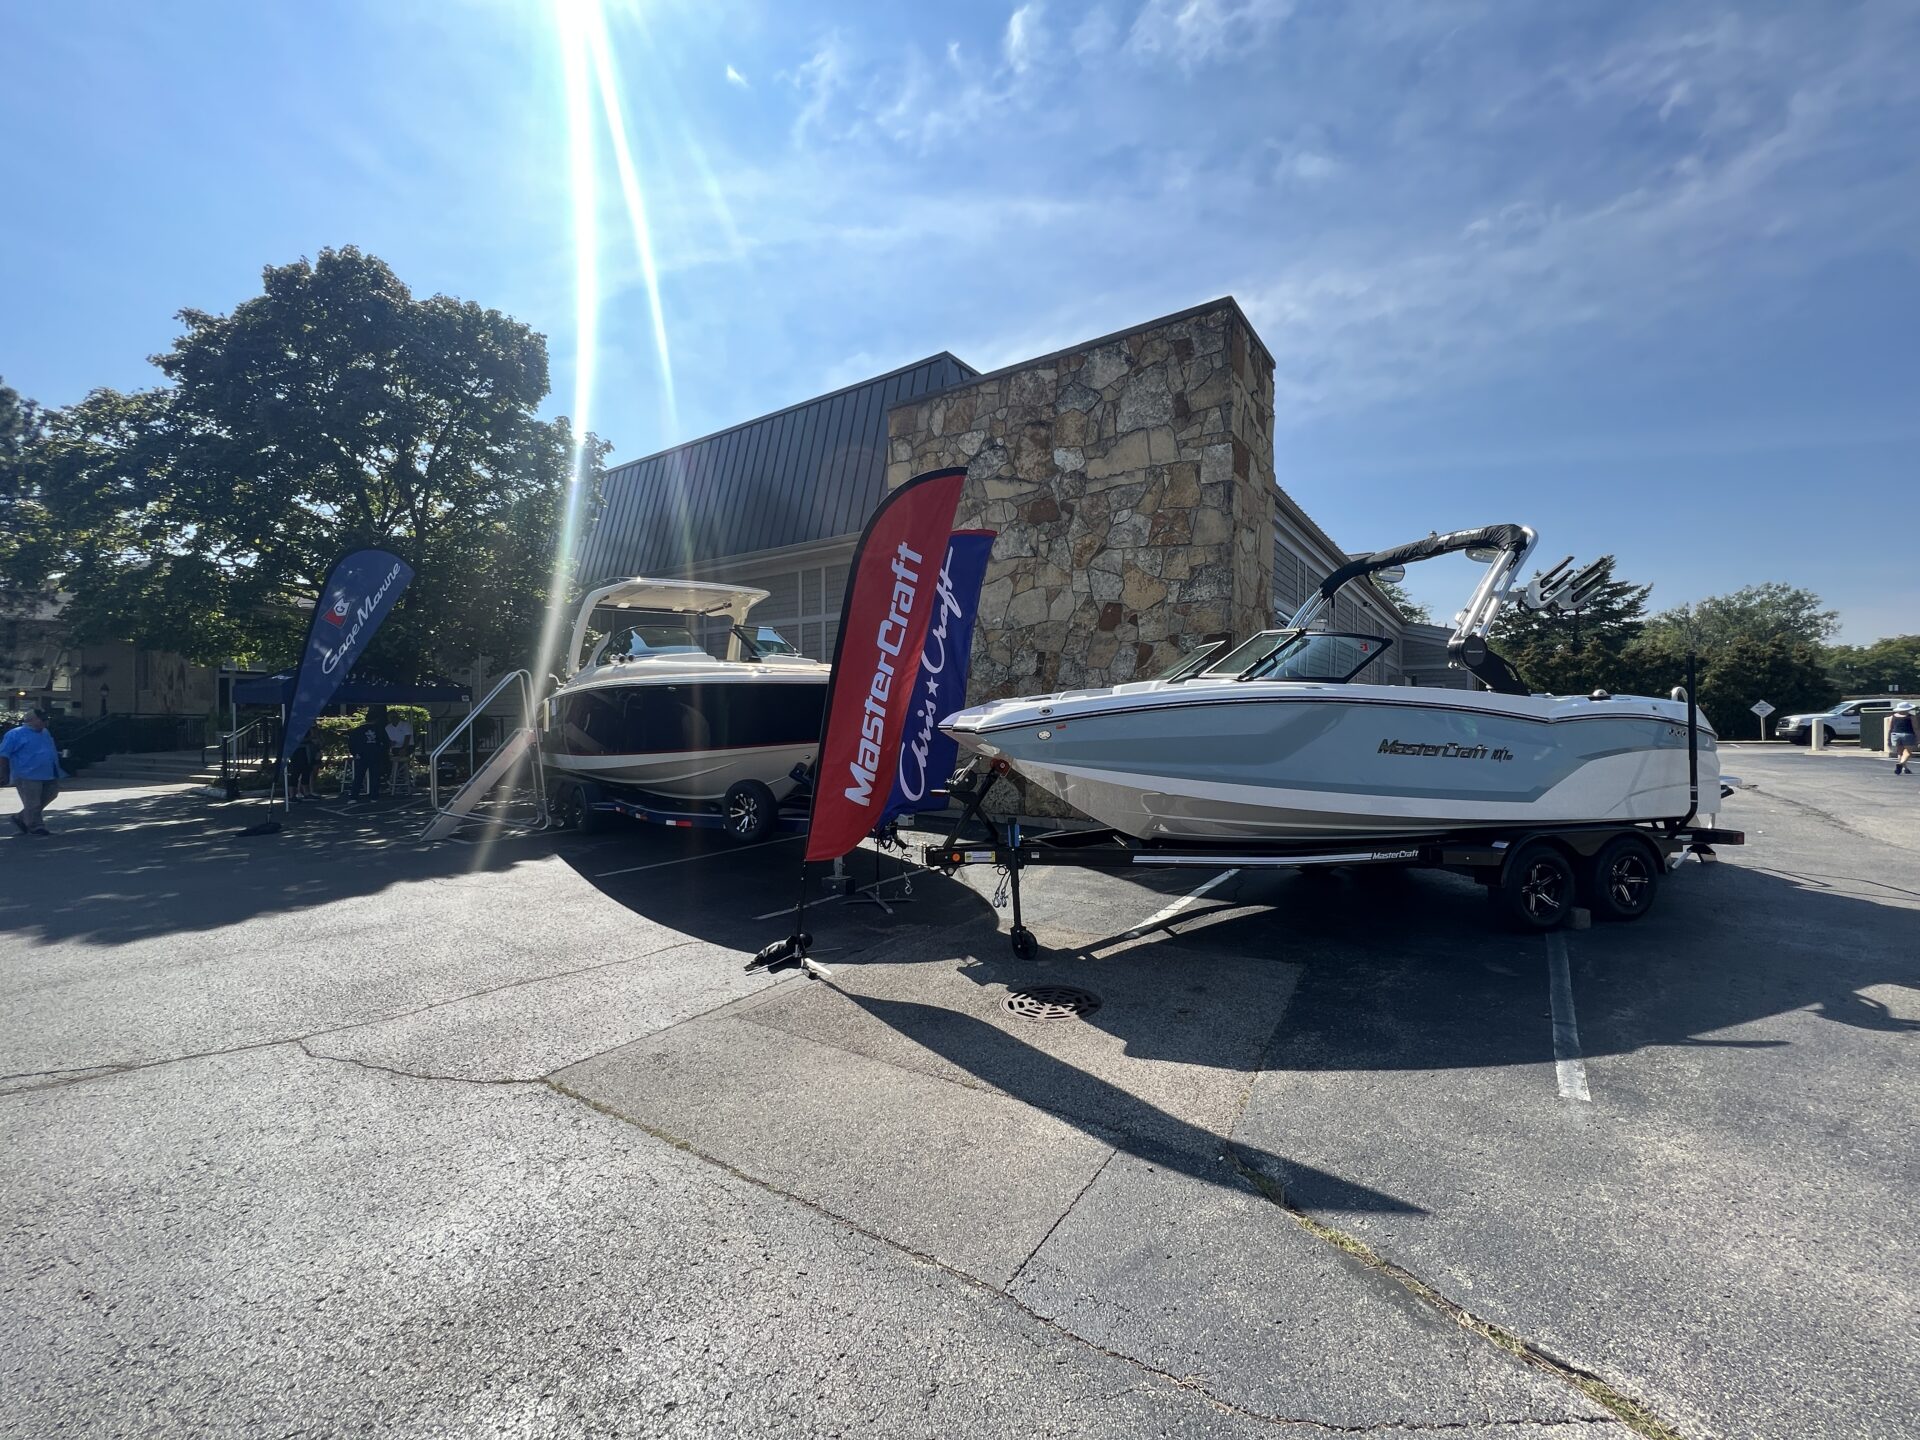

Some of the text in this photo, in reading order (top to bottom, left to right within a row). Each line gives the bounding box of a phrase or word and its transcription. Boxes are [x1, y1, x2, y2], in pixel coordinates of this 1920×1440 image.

[322, 563, 401, 675] Gage Marine
[844, 541, 923, 807] MasterCraft
[900, 546, 962, 801] Chris Craft
[1377, 738, 1488, 760] MasterCraft
[1372, 849, 1419, 860] MasterCraft
